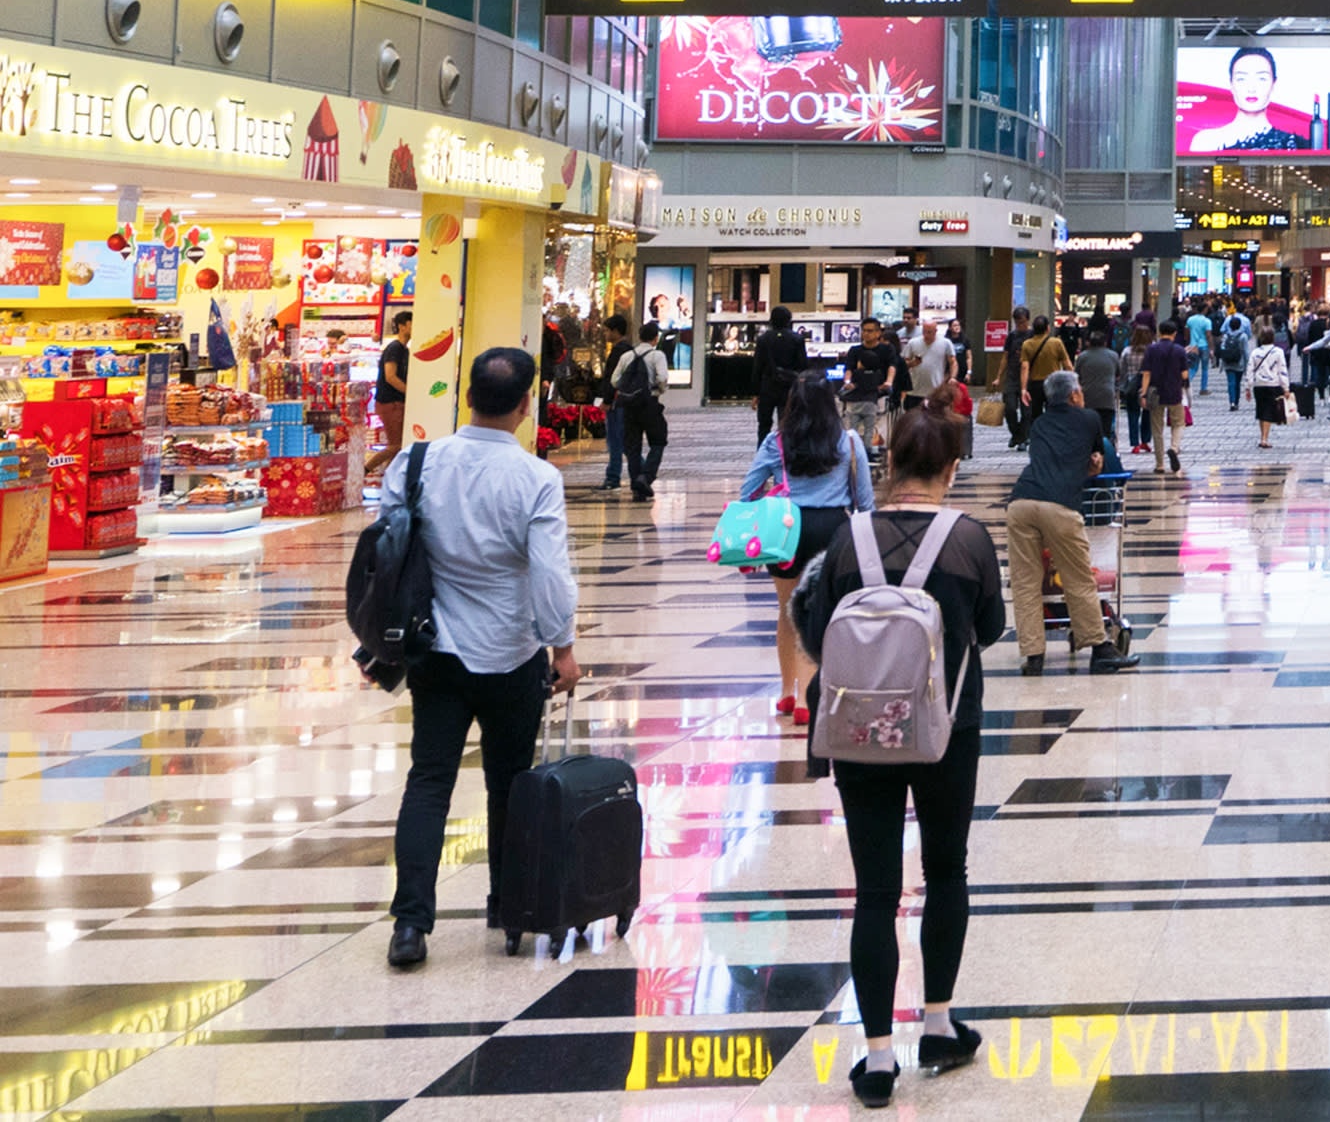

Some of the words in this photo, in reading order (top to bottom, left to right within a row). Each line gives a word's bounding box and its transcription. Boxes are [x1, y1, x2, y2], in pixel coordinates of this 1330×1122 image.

[47, 72, 115, 139] THE
[126, 84, 220, 151] COCOA
[229, 98, 293, 159] TREES
[662, 207, 737, 223] MAISON
[747, 206, 768, 223] de
[777, 207, 863, 223] CHRONUS
[719, 228, 751, 237] WATCH
[753, 228, 807, 237] COLLECTION
[921, 221, 943, 233] duty
[945, 221, 967, 231] free
